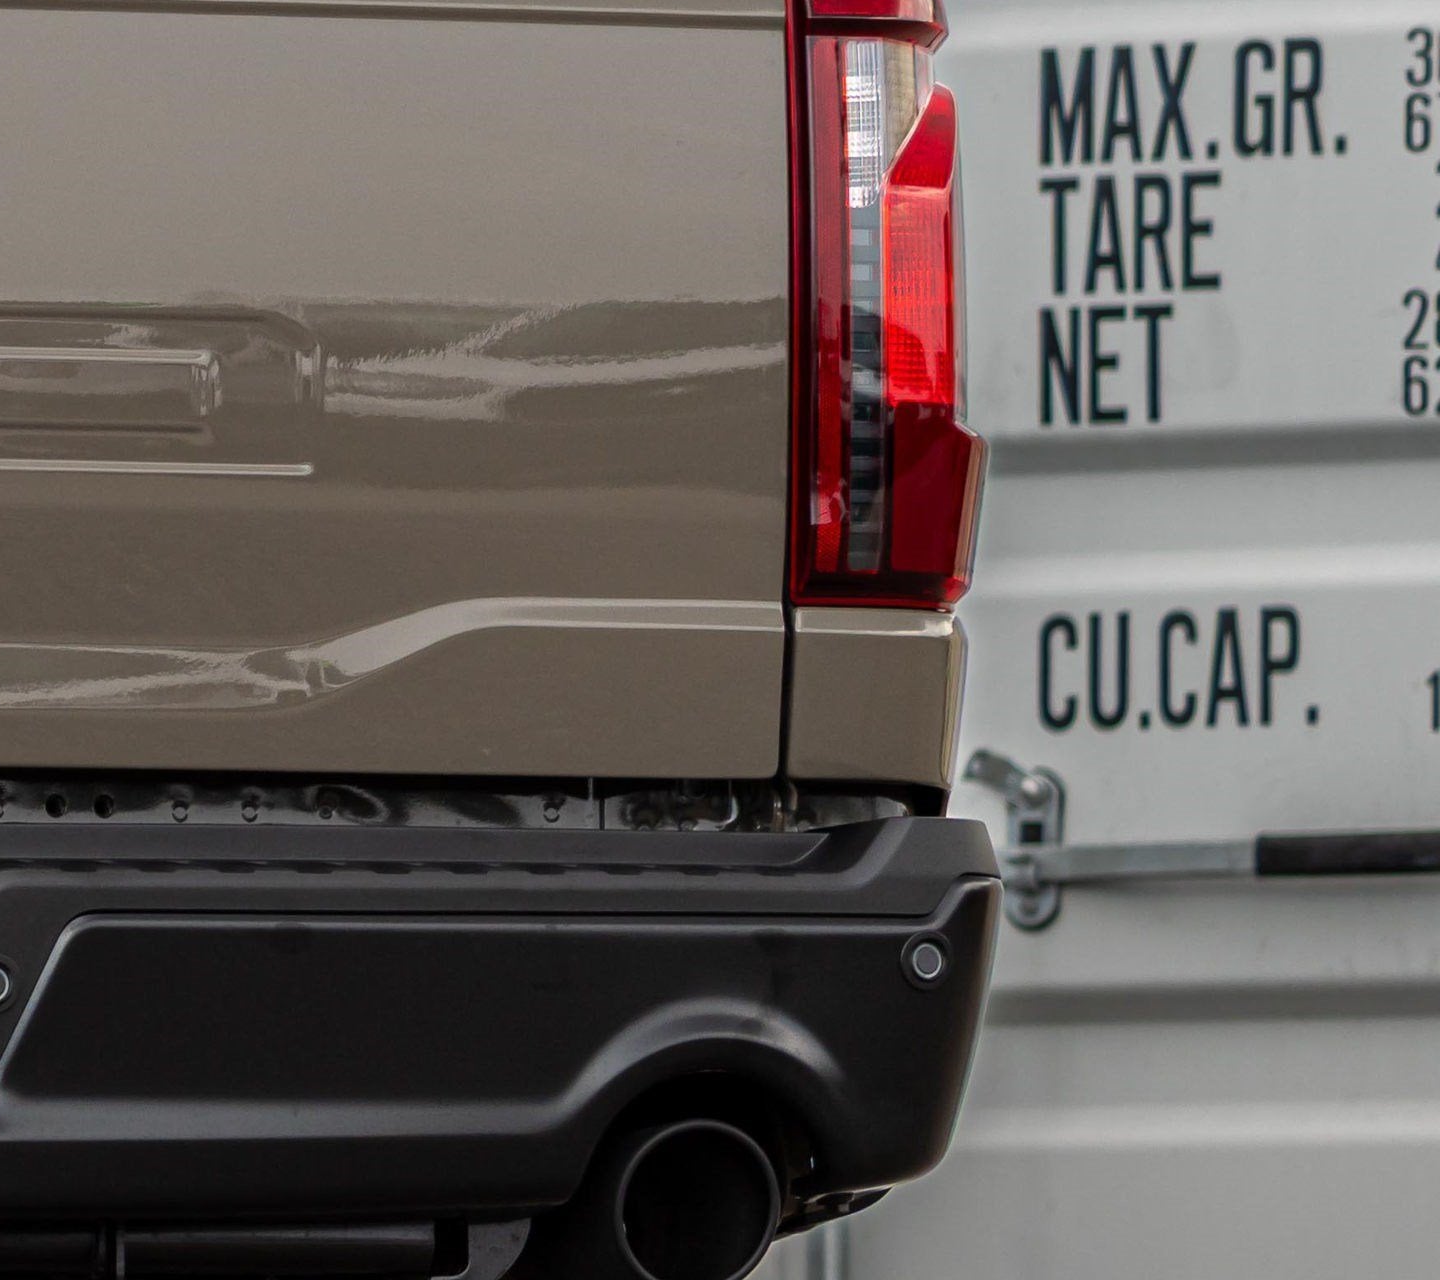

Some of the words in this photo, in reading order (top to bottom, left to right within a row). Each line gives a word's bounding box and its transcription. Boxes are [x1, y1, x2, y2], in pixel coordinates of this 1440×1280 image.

[1039, 170, 1223, 295] TARE
[1039, 303, 1174, 427] NET
[1037, 605, 1321, 734] CU.CAP.
